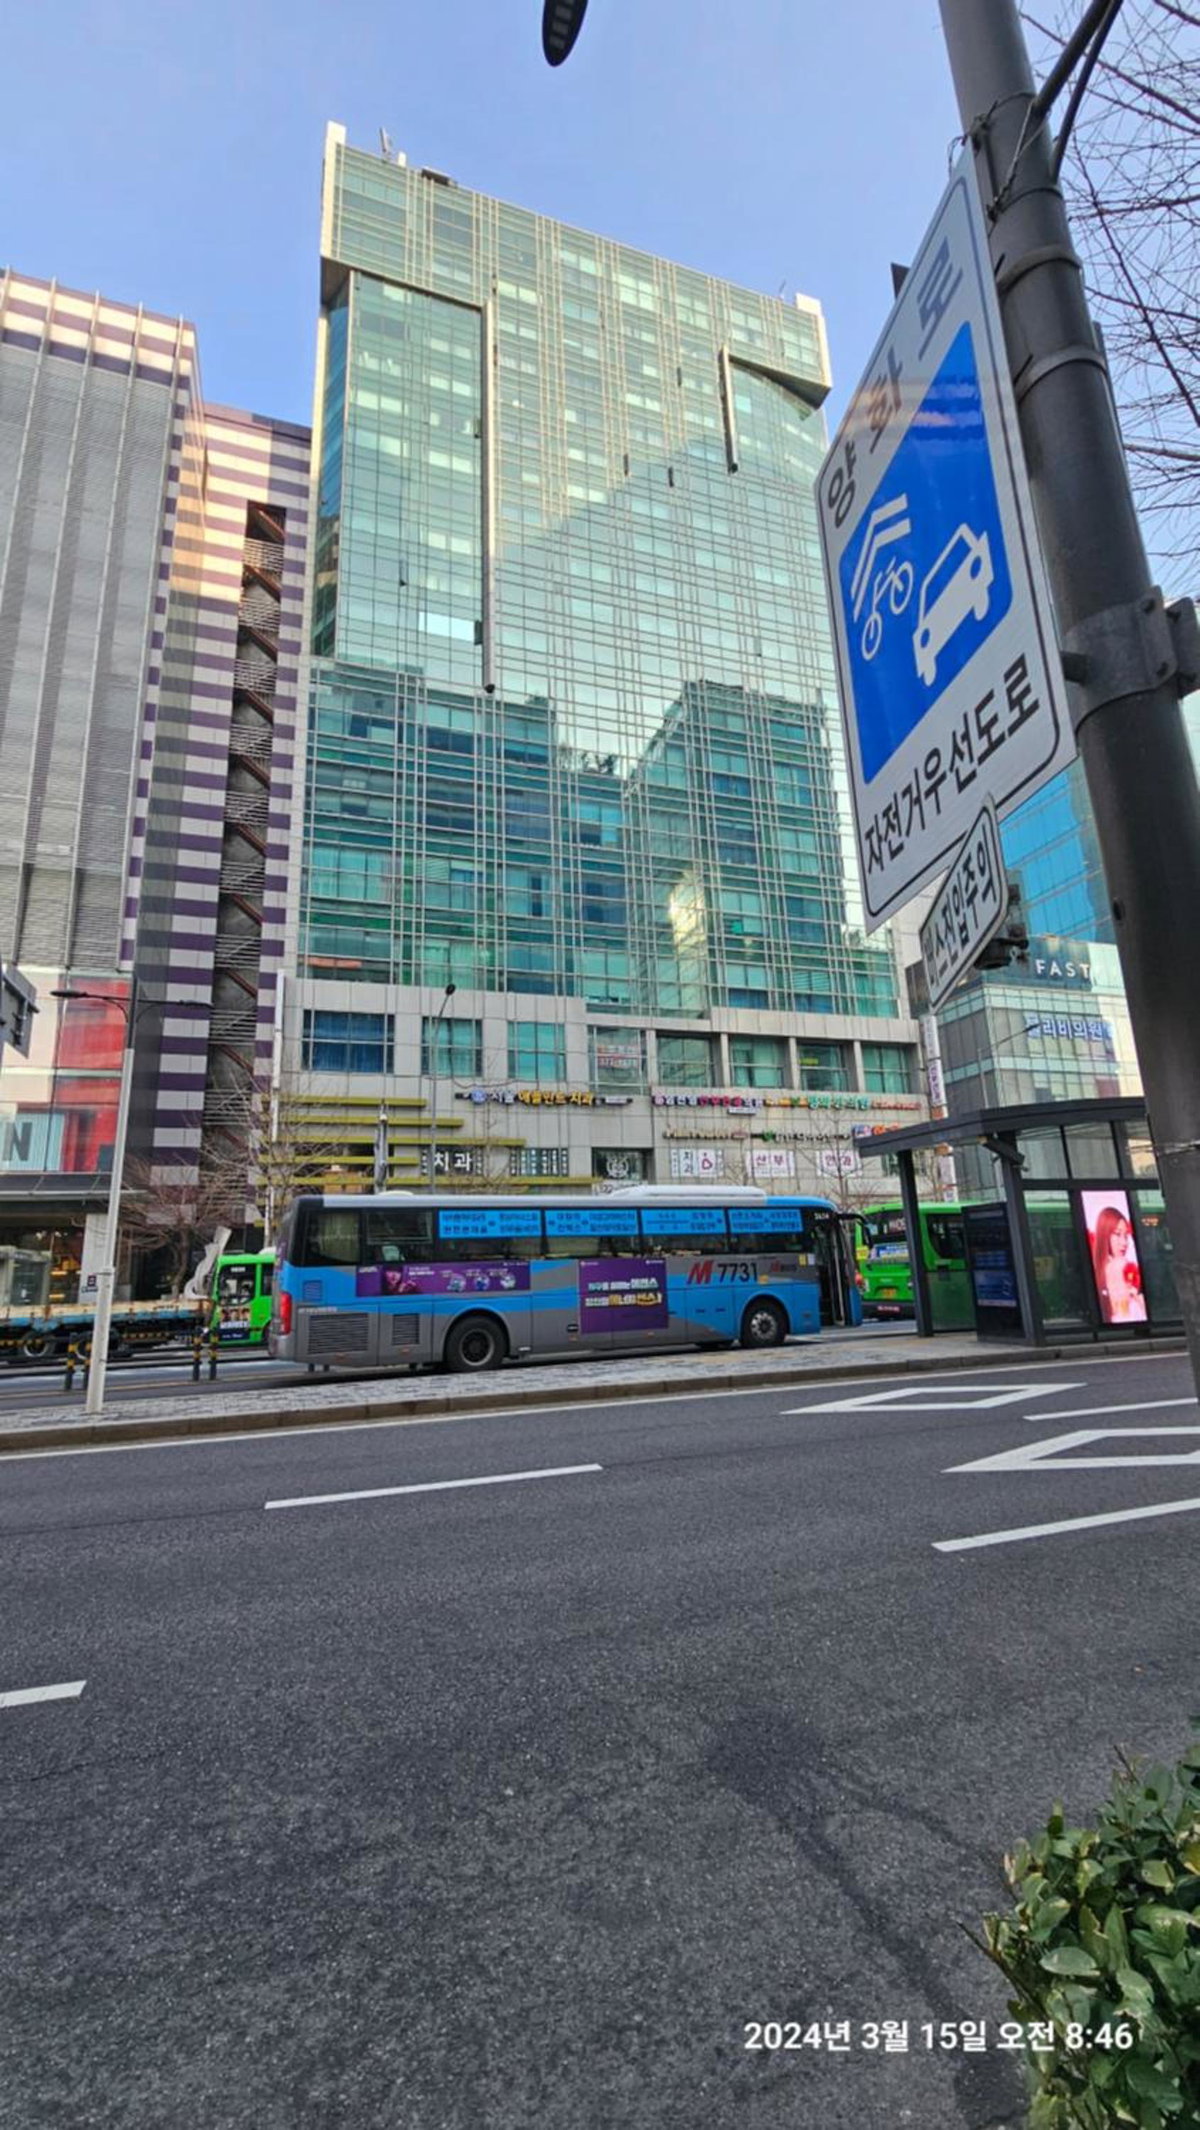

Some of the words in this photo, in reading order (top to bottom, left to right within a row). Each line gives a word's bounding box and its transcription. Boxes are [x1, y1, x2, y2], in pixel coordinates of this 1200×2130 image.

[865, 653, 1040, 875] 자전거우선도로
[1035, 959, 1091, 979] FAST
[433, 1152, 474, 1172] 치과
